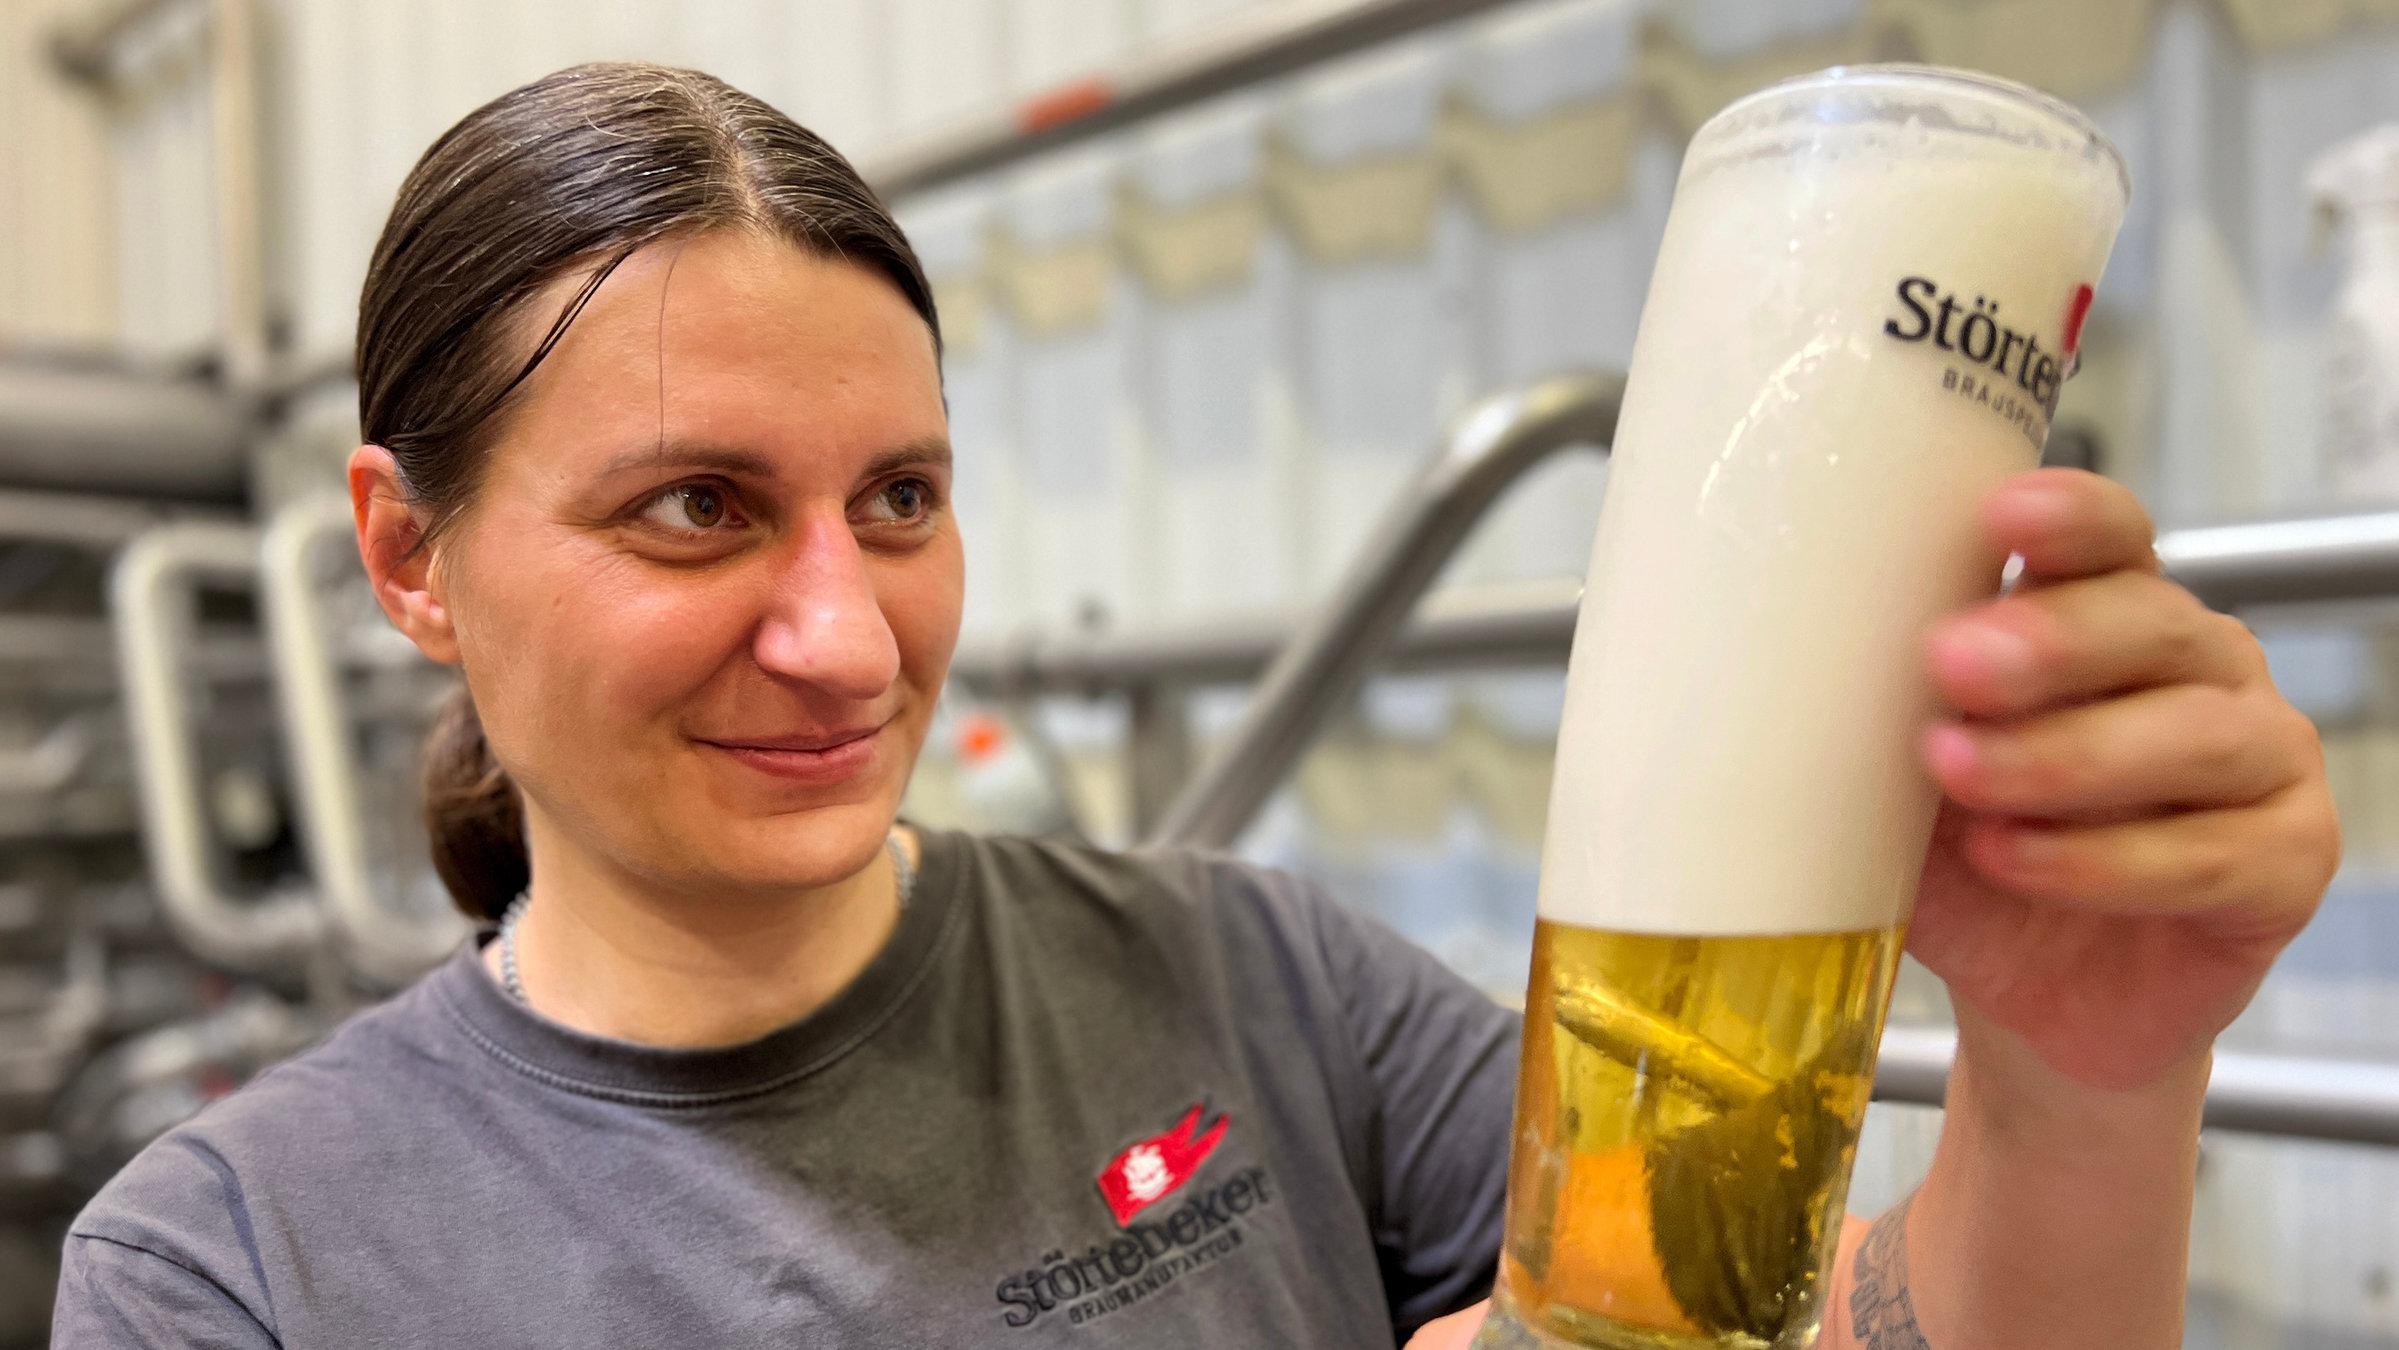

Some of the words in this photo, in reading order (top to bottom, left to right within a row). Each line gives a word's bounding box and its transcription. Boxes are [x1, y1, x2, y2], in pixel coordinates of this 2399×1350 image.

[1884, 277, 2064, 406] Störte
[996, 1167, 1270, 1327] Störtebeker
[1068, 1229, 1243, 1323] BRAUMANUFAKTUR
